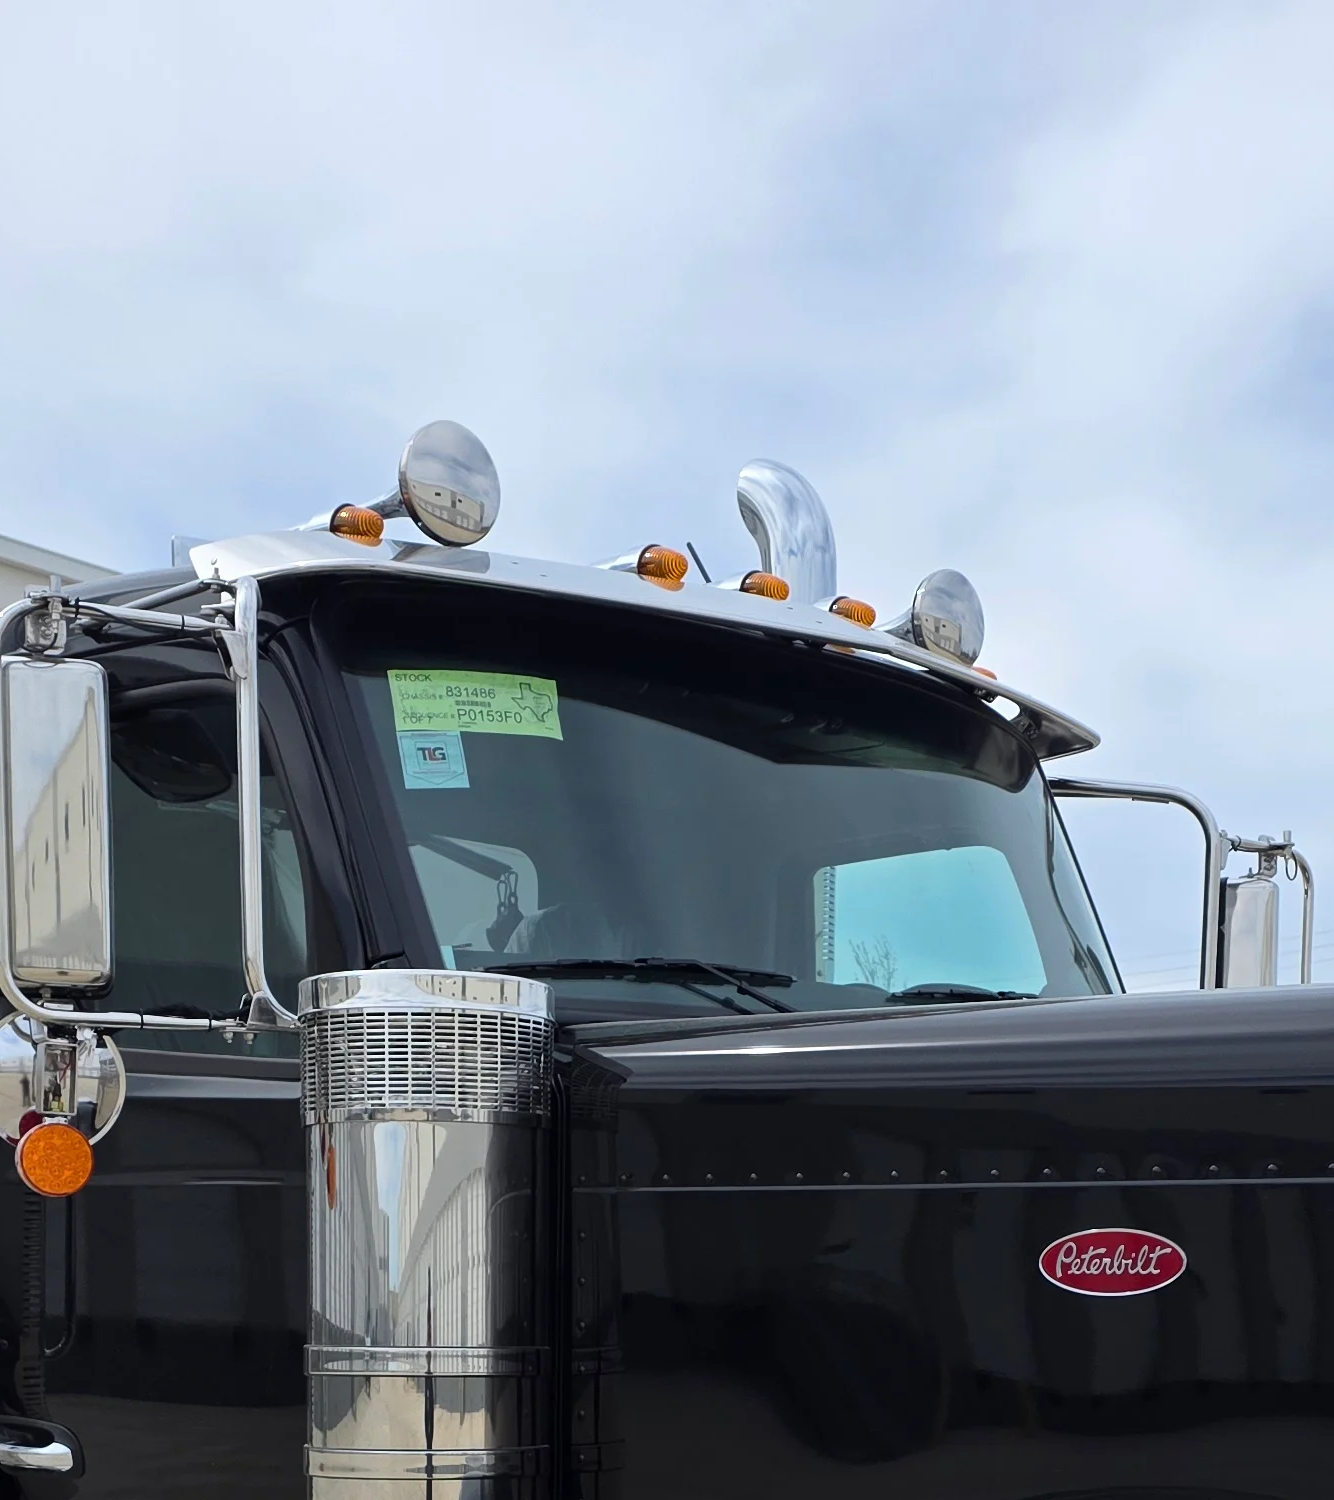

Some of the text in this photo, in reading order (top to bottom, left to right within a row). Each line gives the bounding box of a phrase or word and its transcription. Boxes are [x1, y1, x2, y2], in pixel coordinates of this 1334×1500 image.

[395, 673, 432, 682] STOCK
[445, 686, 496, 699] 831486
[457, 708, 523, 724] P0153F0
[417, 747, 446, 761] TLG
[1055, 1241, 1172, 1278] Peterbilt
